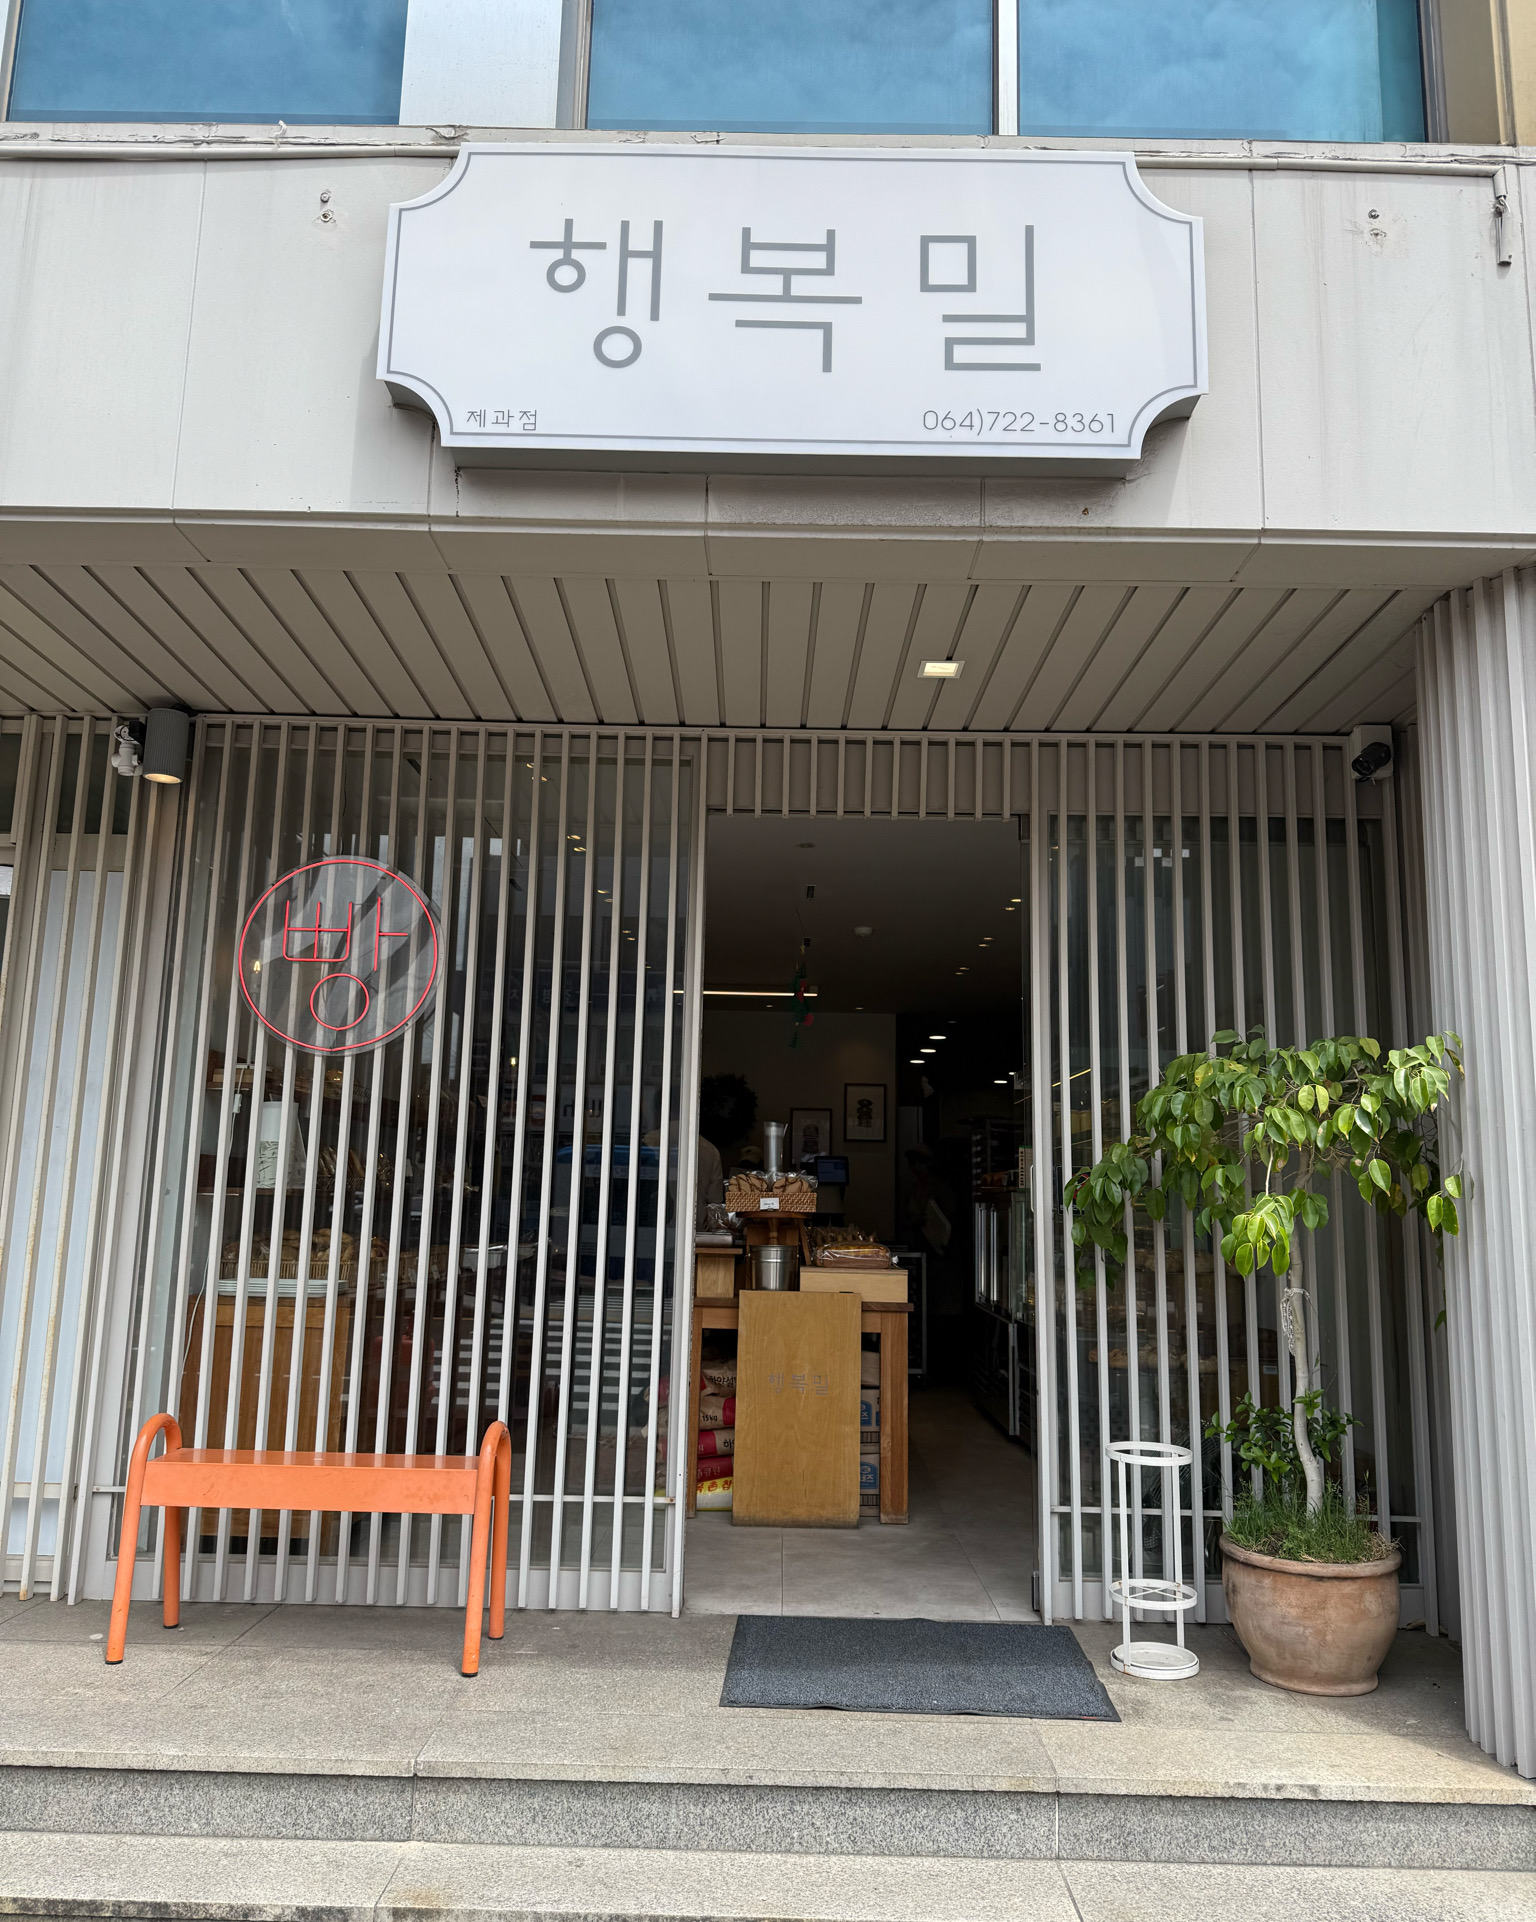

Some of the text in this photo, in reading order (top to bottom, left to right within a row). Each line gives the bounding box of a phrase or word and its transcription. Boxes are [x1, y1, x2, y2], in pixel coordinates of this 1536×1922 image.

[530, 218, 1042, 373] 행복밀
[465, 408, 538, 432] 제과점
[923, 409, 1115, 436] 064)722-8361
[282, 896, 409, 1031] 빵
[767, 1372, 829, 1396] 행복밀
